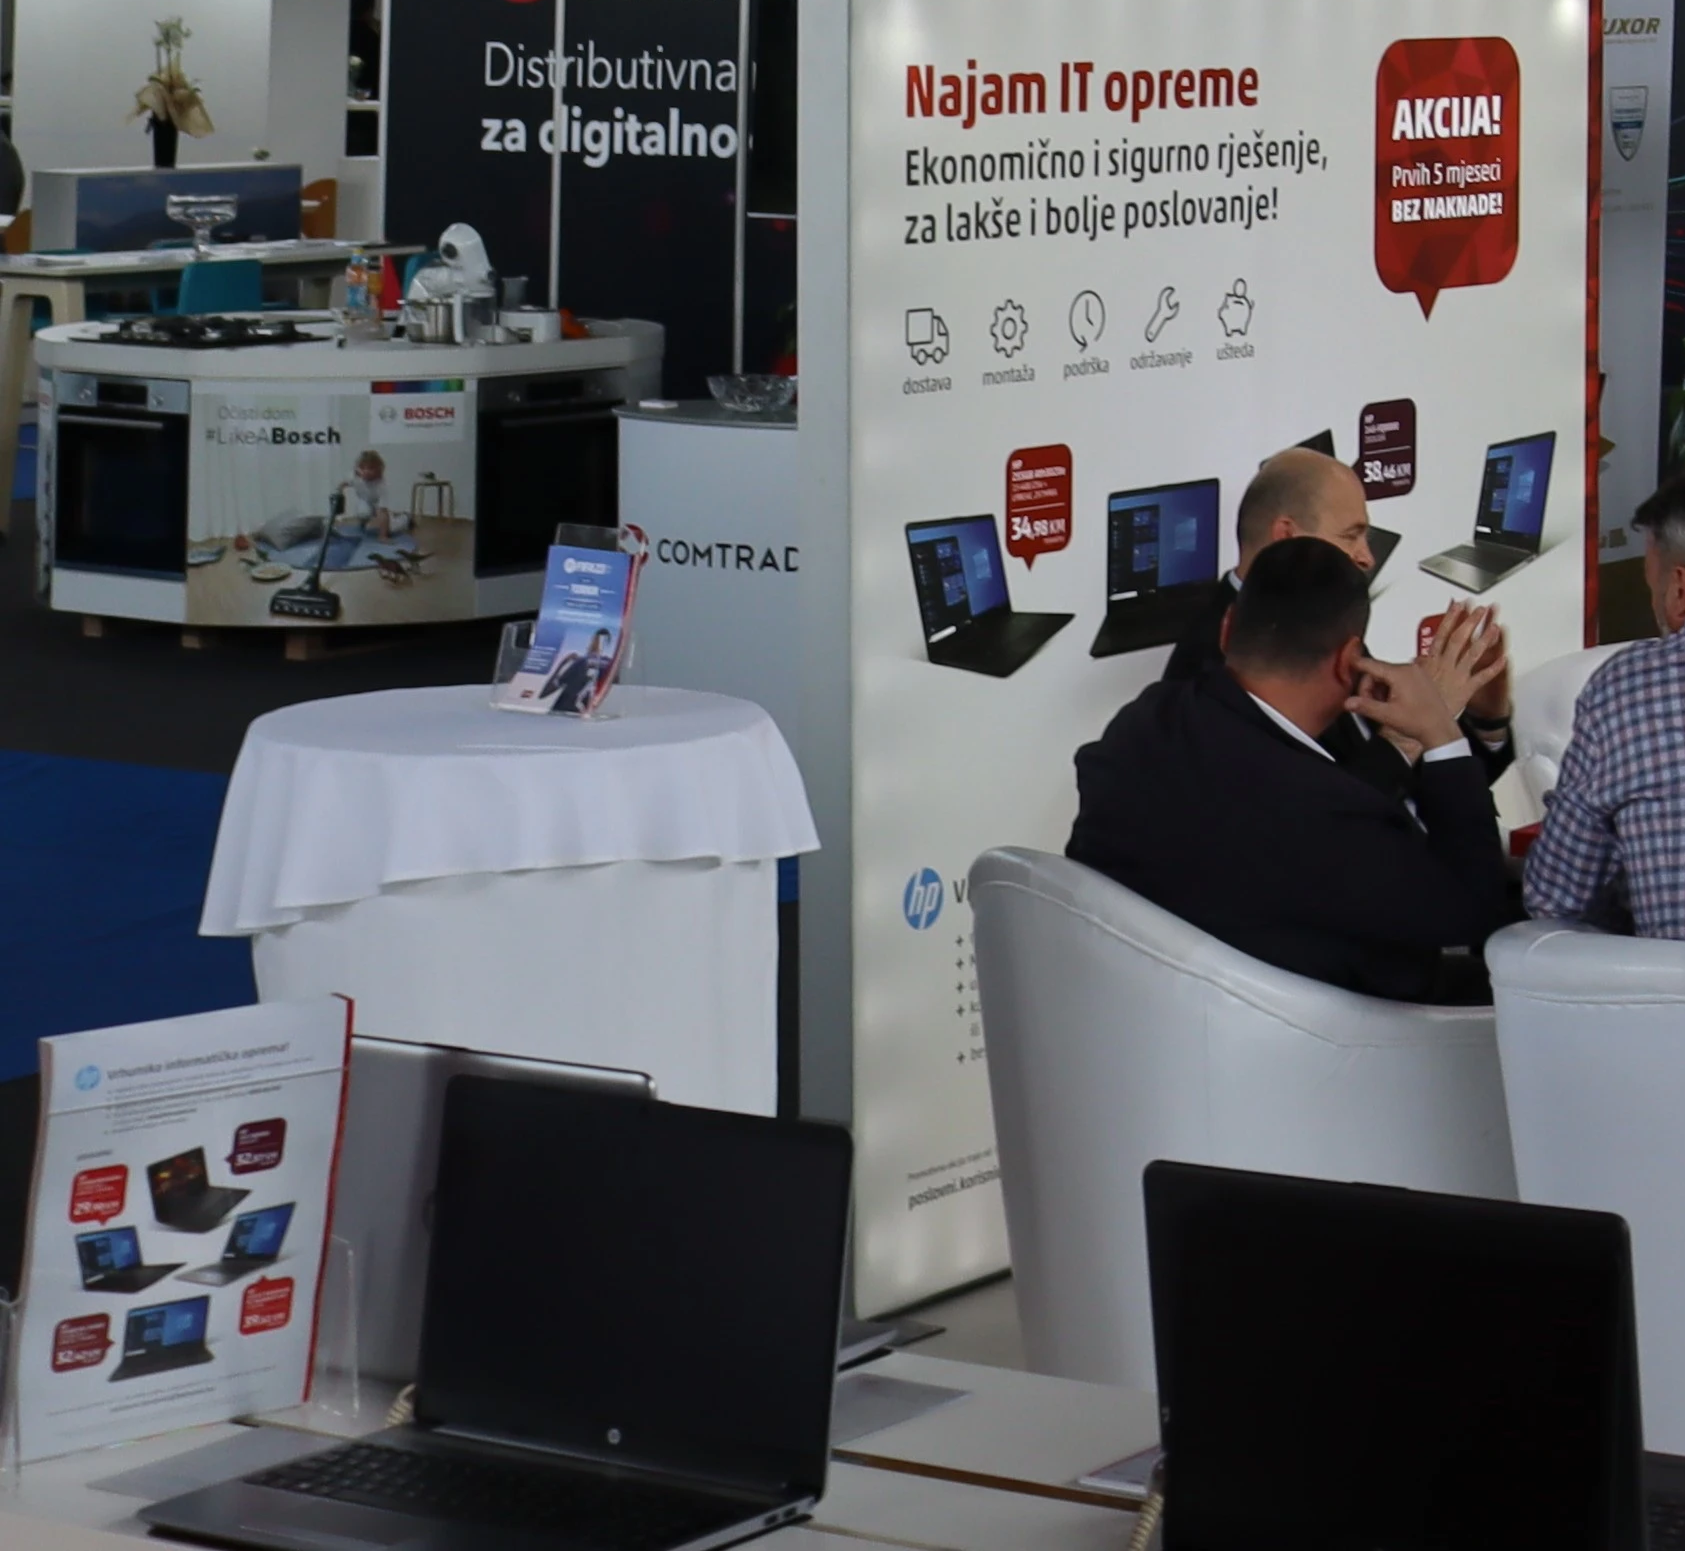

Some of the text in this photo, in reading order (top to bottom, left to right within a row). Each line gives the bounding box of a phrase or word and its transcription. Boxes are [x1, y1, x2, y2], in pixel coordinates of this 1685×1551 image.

[1602, 17, 1661, 36] UXOR
[484, 39, 738, 93] Distributivna
[905, 58, 1260, 130] Najam IT opreme
[1391, 95, 1502, 141] AKCIJA!
[480, 104, 739, 168] za digitalno
[905, 128, 1329, 187] Ekonomično i sigurno rješenje,
[1392, 156, 1502, 189] Prvih 5 mjeseci
[904, 186, 1280, 245] za lakše i bolje poslovanje!
[1391, 192, 1503, 223] BEZ NAKNADE!
[982, 365, 1035, 386] montaža
[1062, 356, 1110, 380] podrška
[1129, 349, 1193, 371] održavanje
[902, 375, 952, 395] dostava
[403, 407, 456, 420] BOSCH
[205, 425, 341, 446] #LikeABosch
[656, 538, 800, 573] COMTRAD
